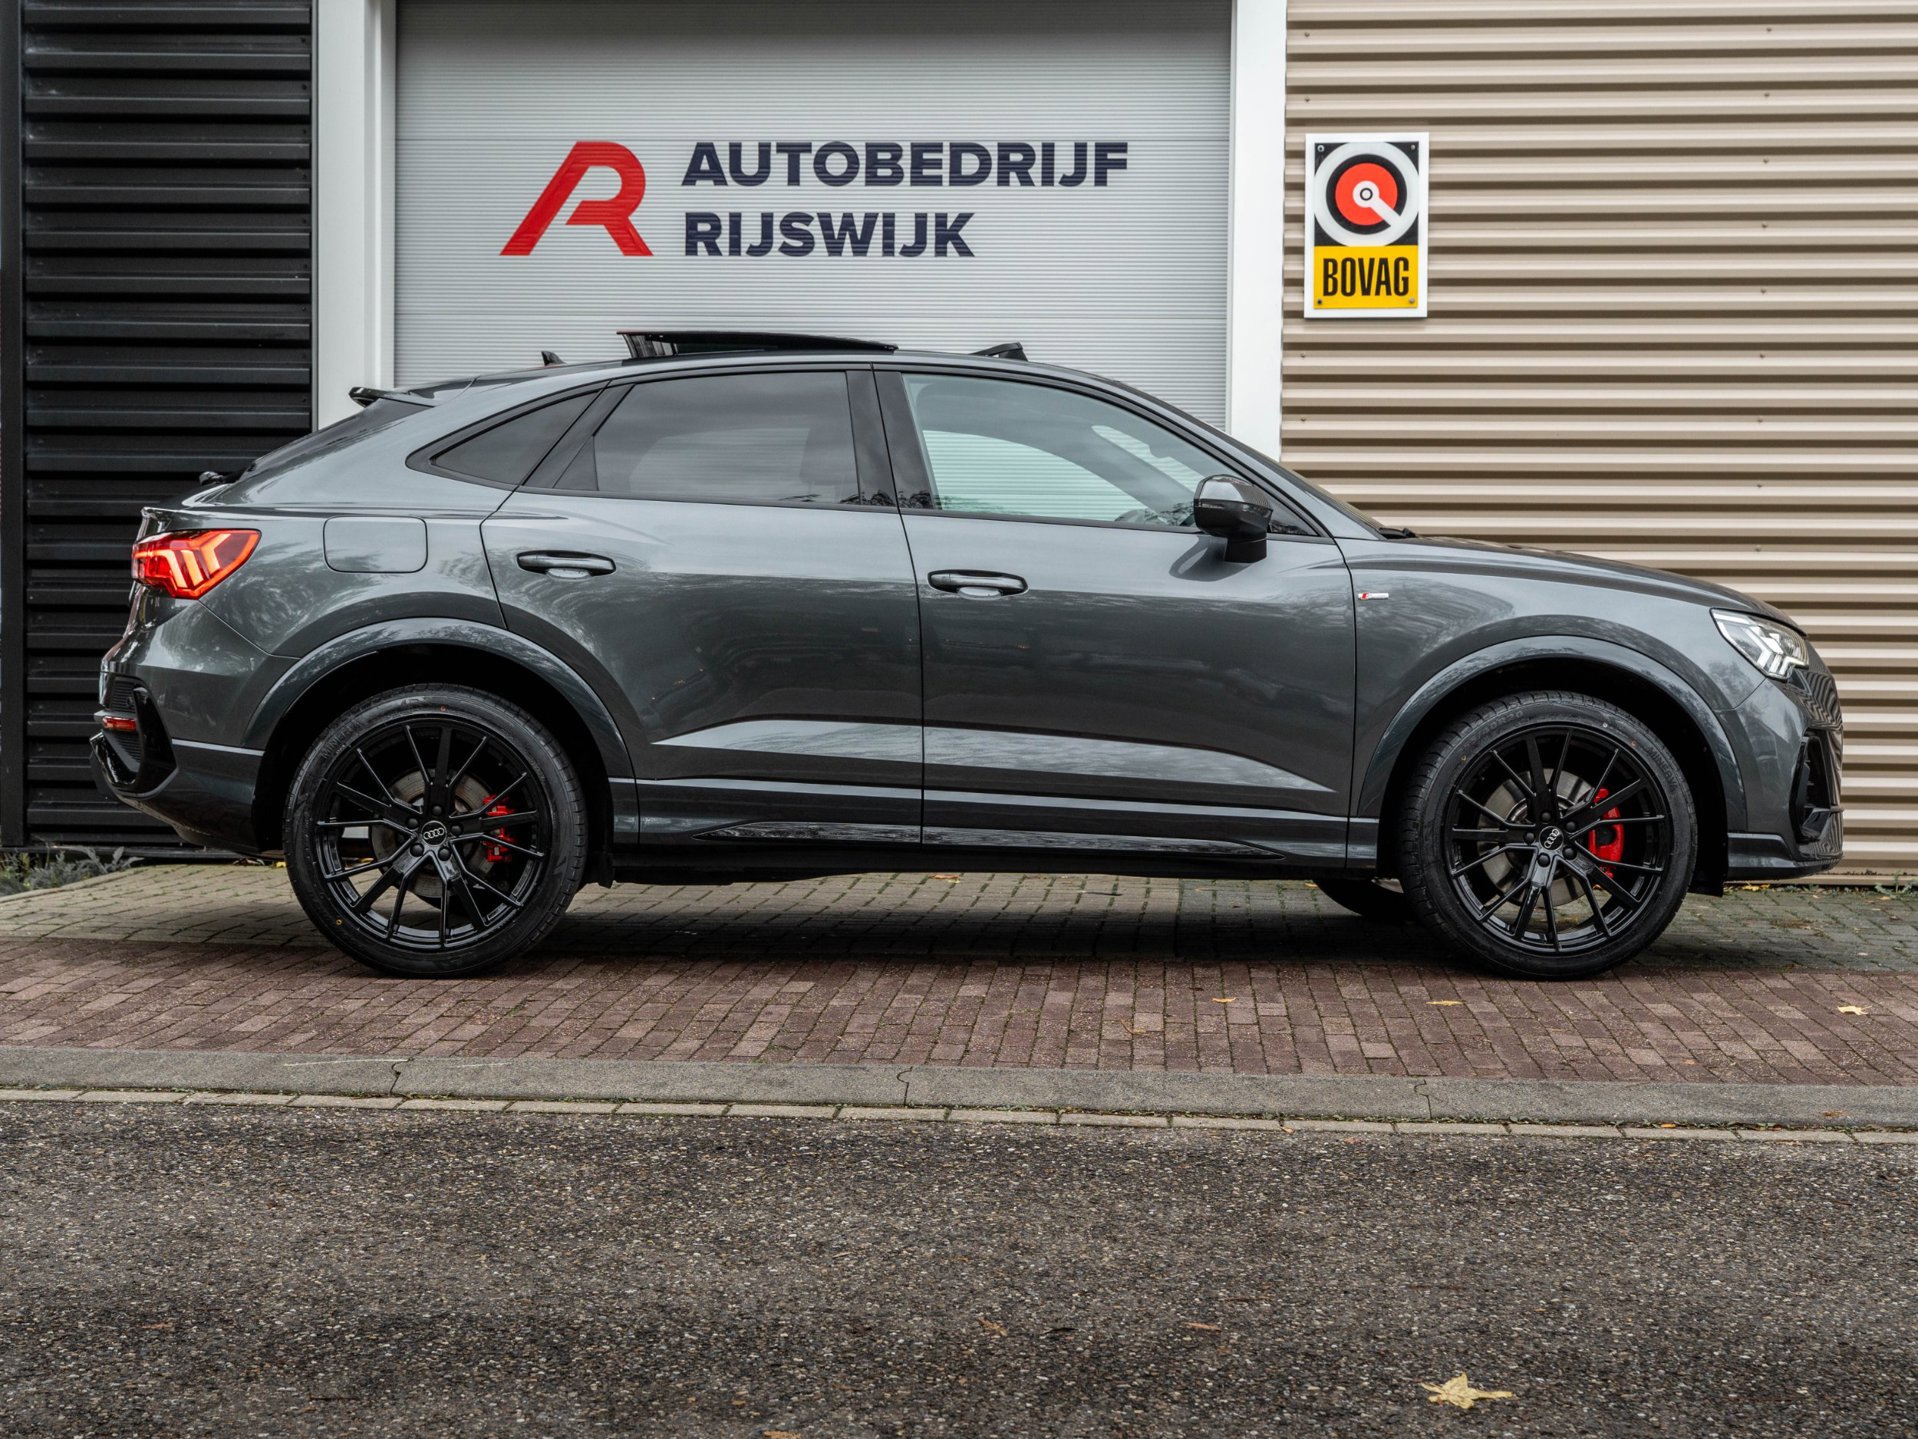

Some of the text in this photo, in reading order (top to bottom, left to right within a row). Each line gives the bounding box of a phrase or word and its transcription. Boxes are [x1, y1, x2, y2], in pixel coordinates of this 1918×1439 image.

[681, 141, 1129, 187] AUTOBEDRIJF
[684, 212, 976, 257] RIJSWIJK
[1323, 257, 1409, 297] BOVAG
[1647, 747, 1678, 792] MINERVA
